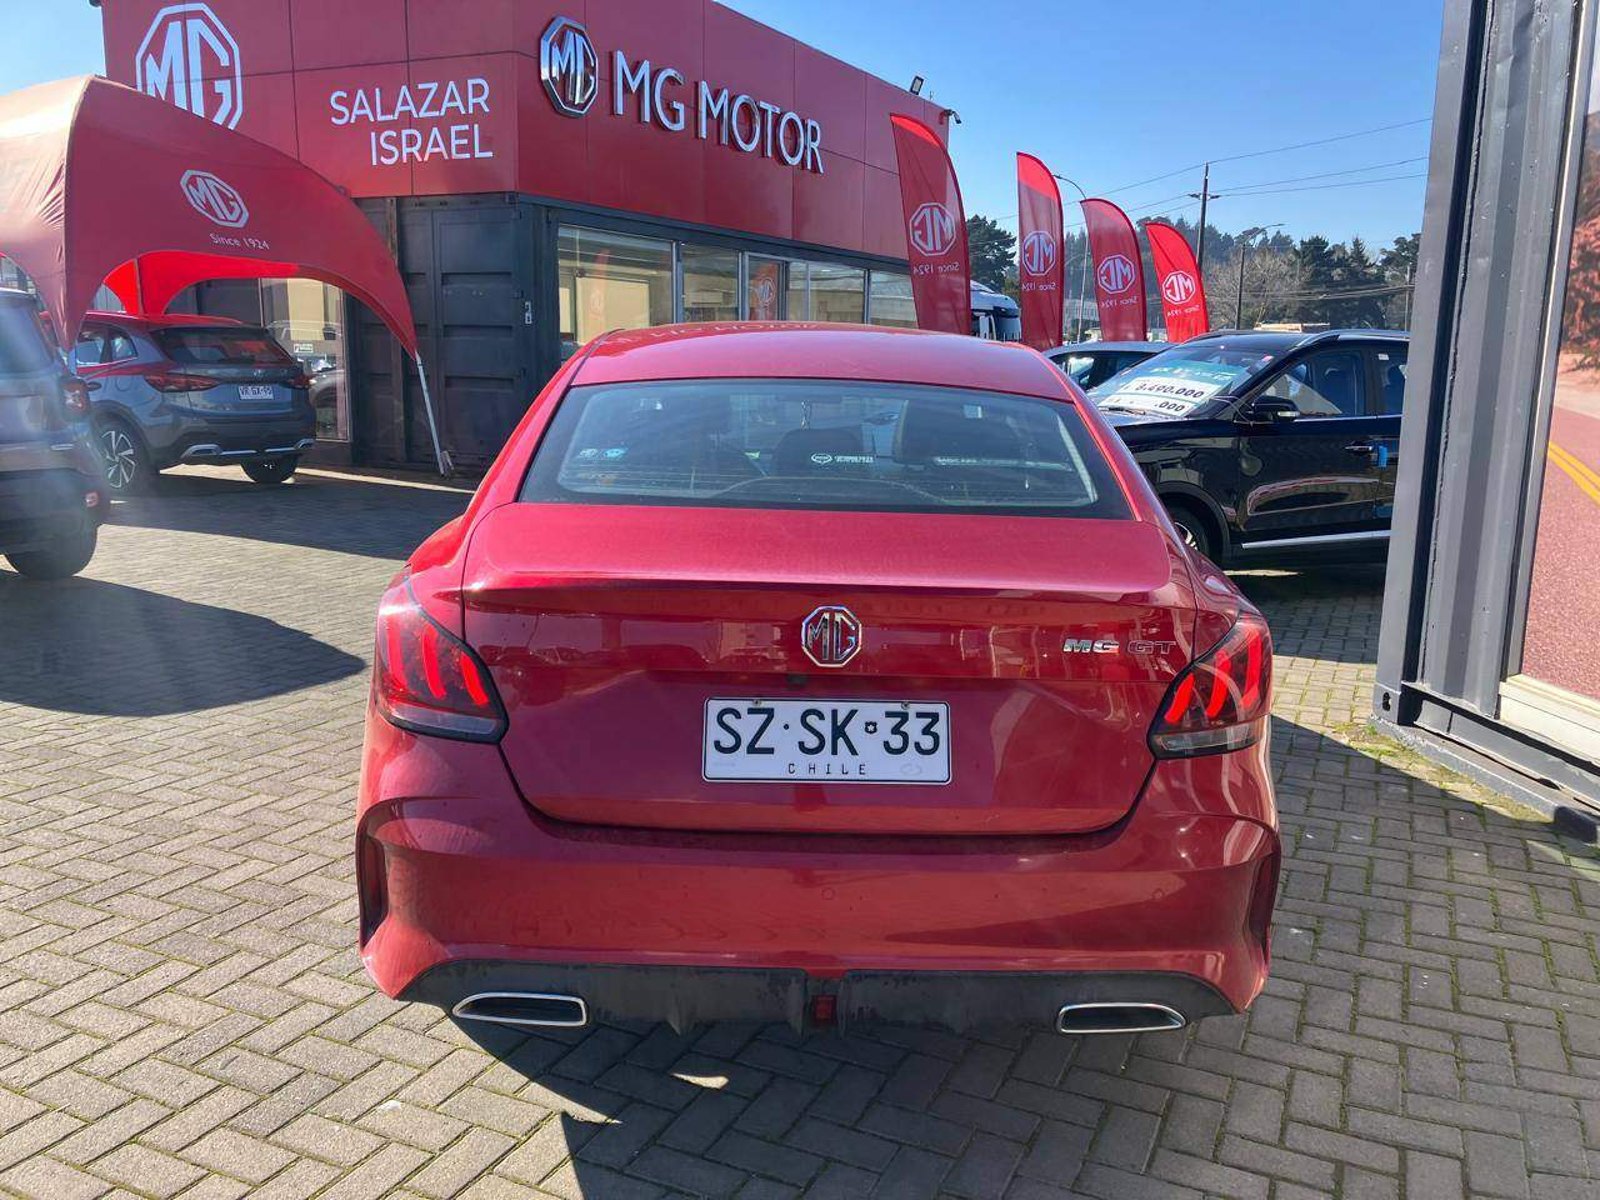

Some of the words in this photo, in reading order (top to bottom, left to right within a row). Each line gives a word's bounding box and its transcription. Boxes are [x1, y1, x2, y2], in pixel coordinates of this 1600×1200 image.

[145, 18, 232, 126] MG
[329, 76, 491, 126] SALAZAR
[611, 49, 685, 131] MG
[698, 79, 824, 174] MOTOR
[370, 123, 494, 166] ISRAEL
[187, 175, 242, 222] MG
[209, 233, 241, 247] Since
[242, 237, 270, 250] 1924
[807, 611, 856, 661] MG
[1063, 638, 1119, 654] MG
[1127, 640, 1177, 654] GT
[788, 763, 867, 776] CHILE
